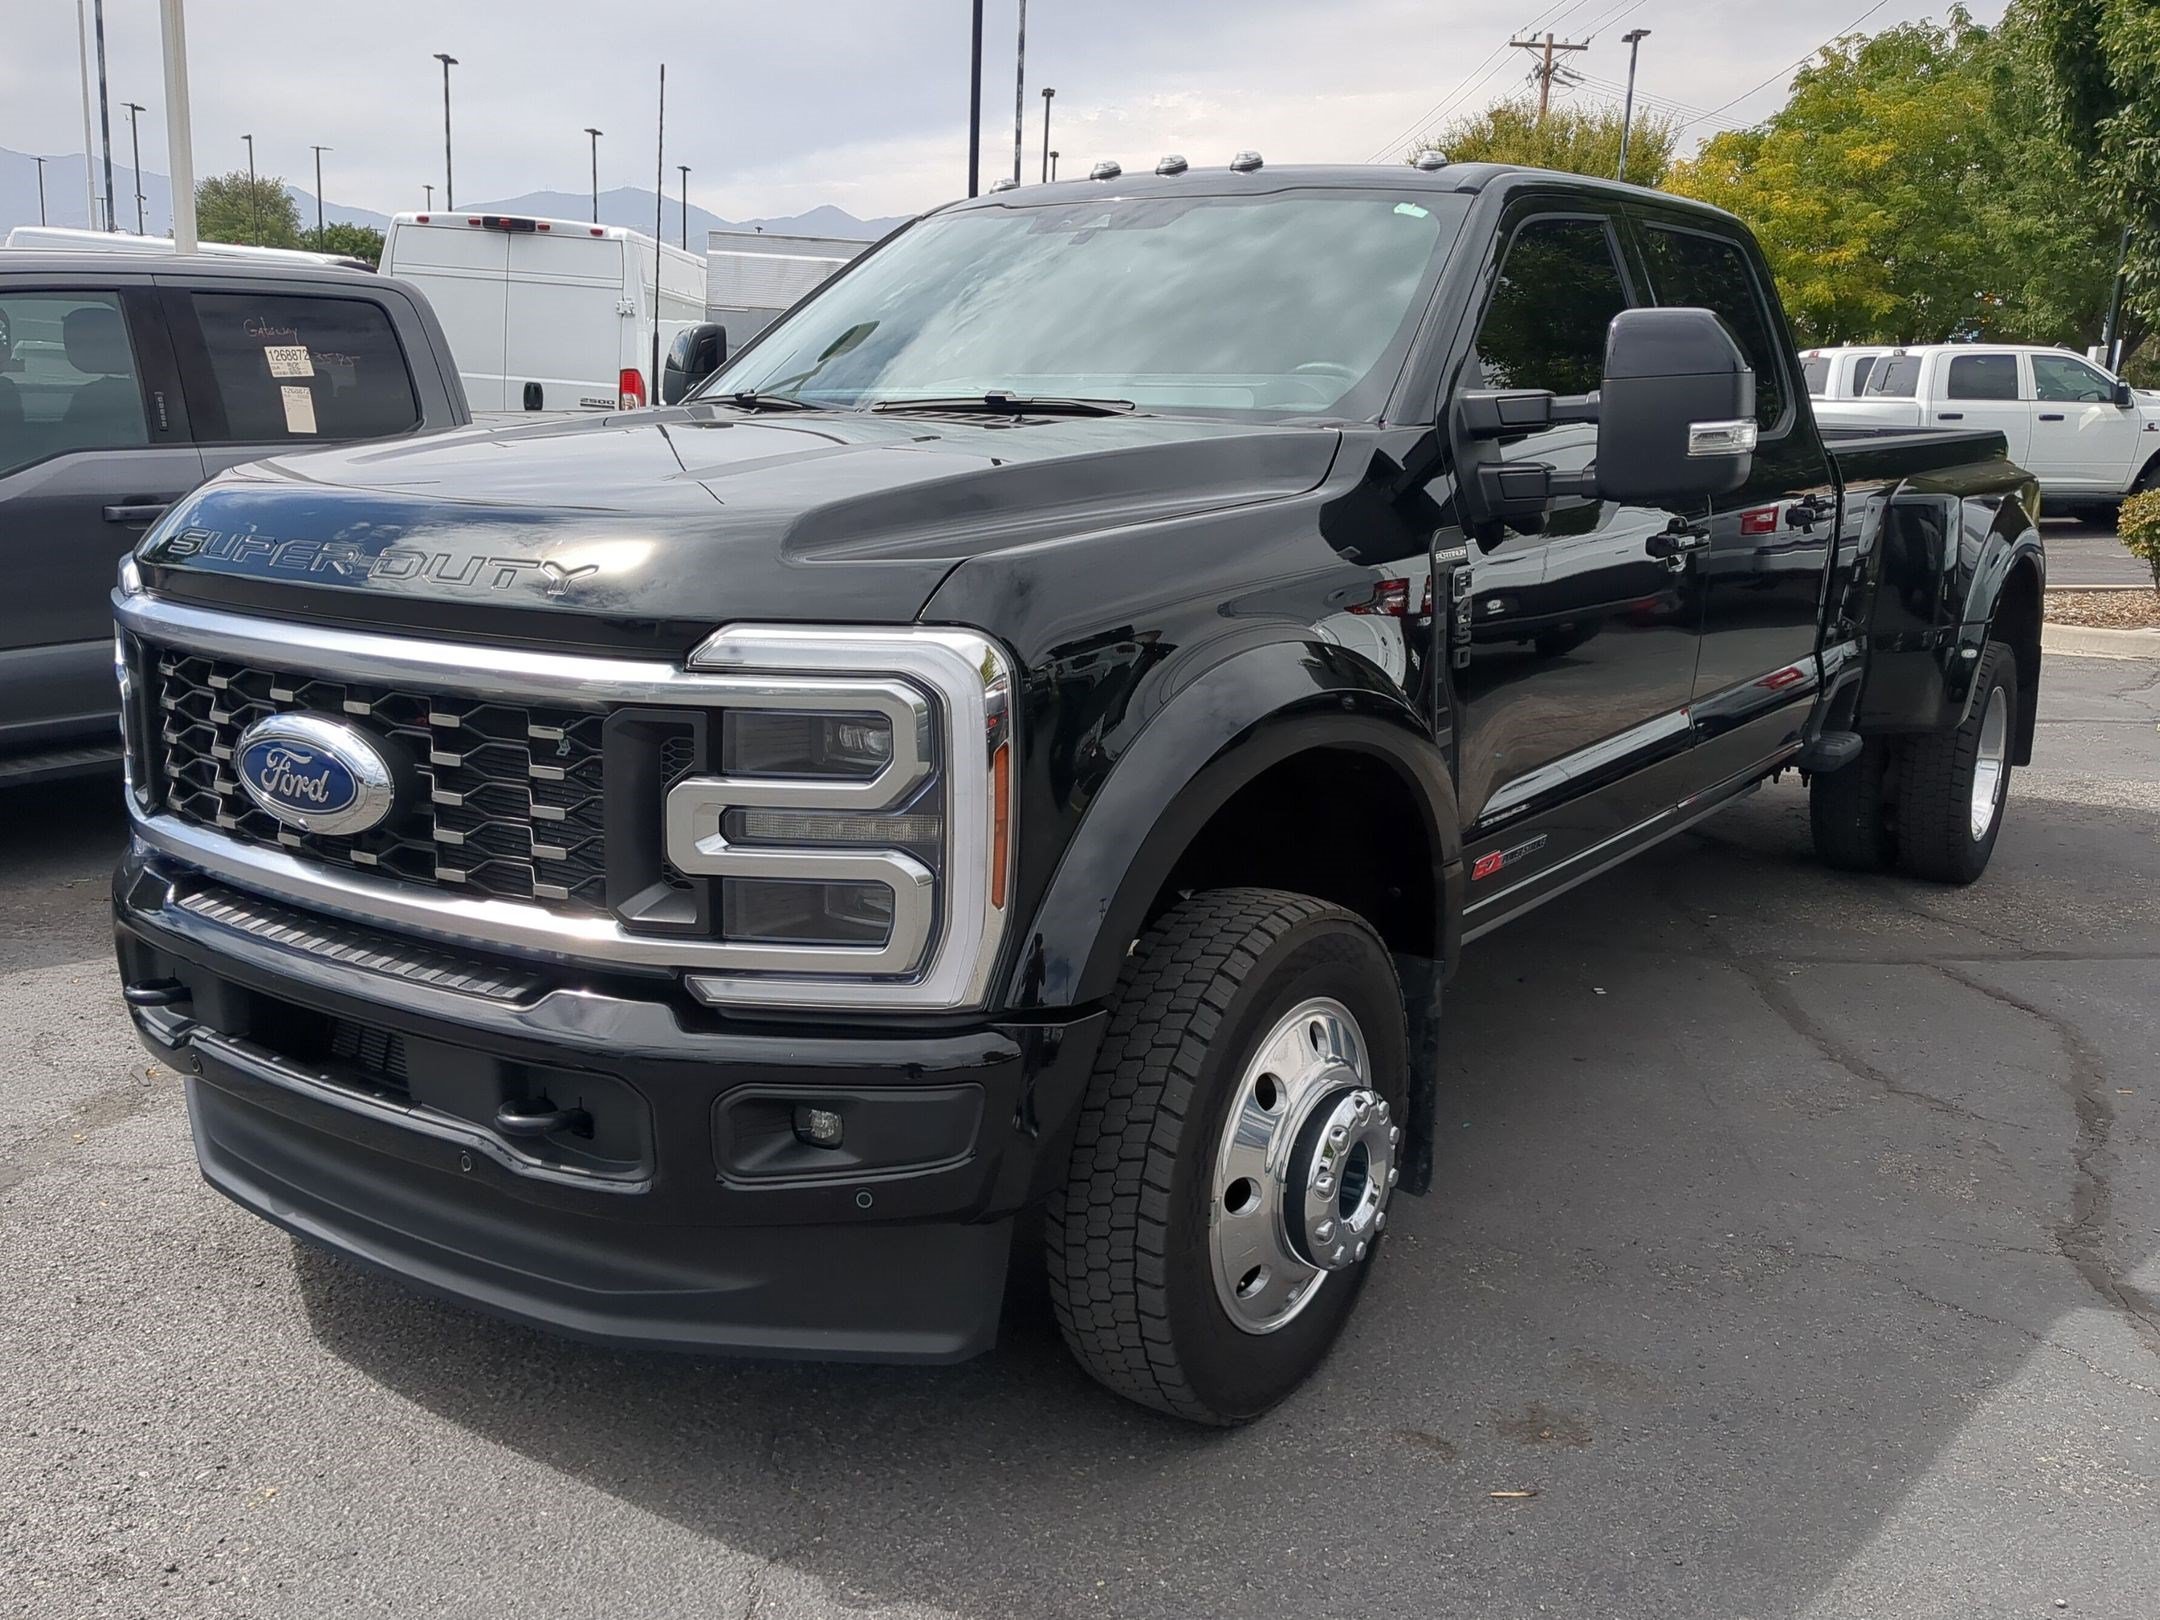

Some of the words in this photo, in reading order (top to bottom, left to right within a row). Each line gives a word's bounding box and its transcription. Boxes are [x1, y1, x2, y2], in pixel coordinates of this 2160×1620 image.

[268, 349, 310, 361] 1268872
[168, 526, 362, 577] SUPER
[367, 547, 600, 596] DUTY
[260, 748, 331, 803] Ford
